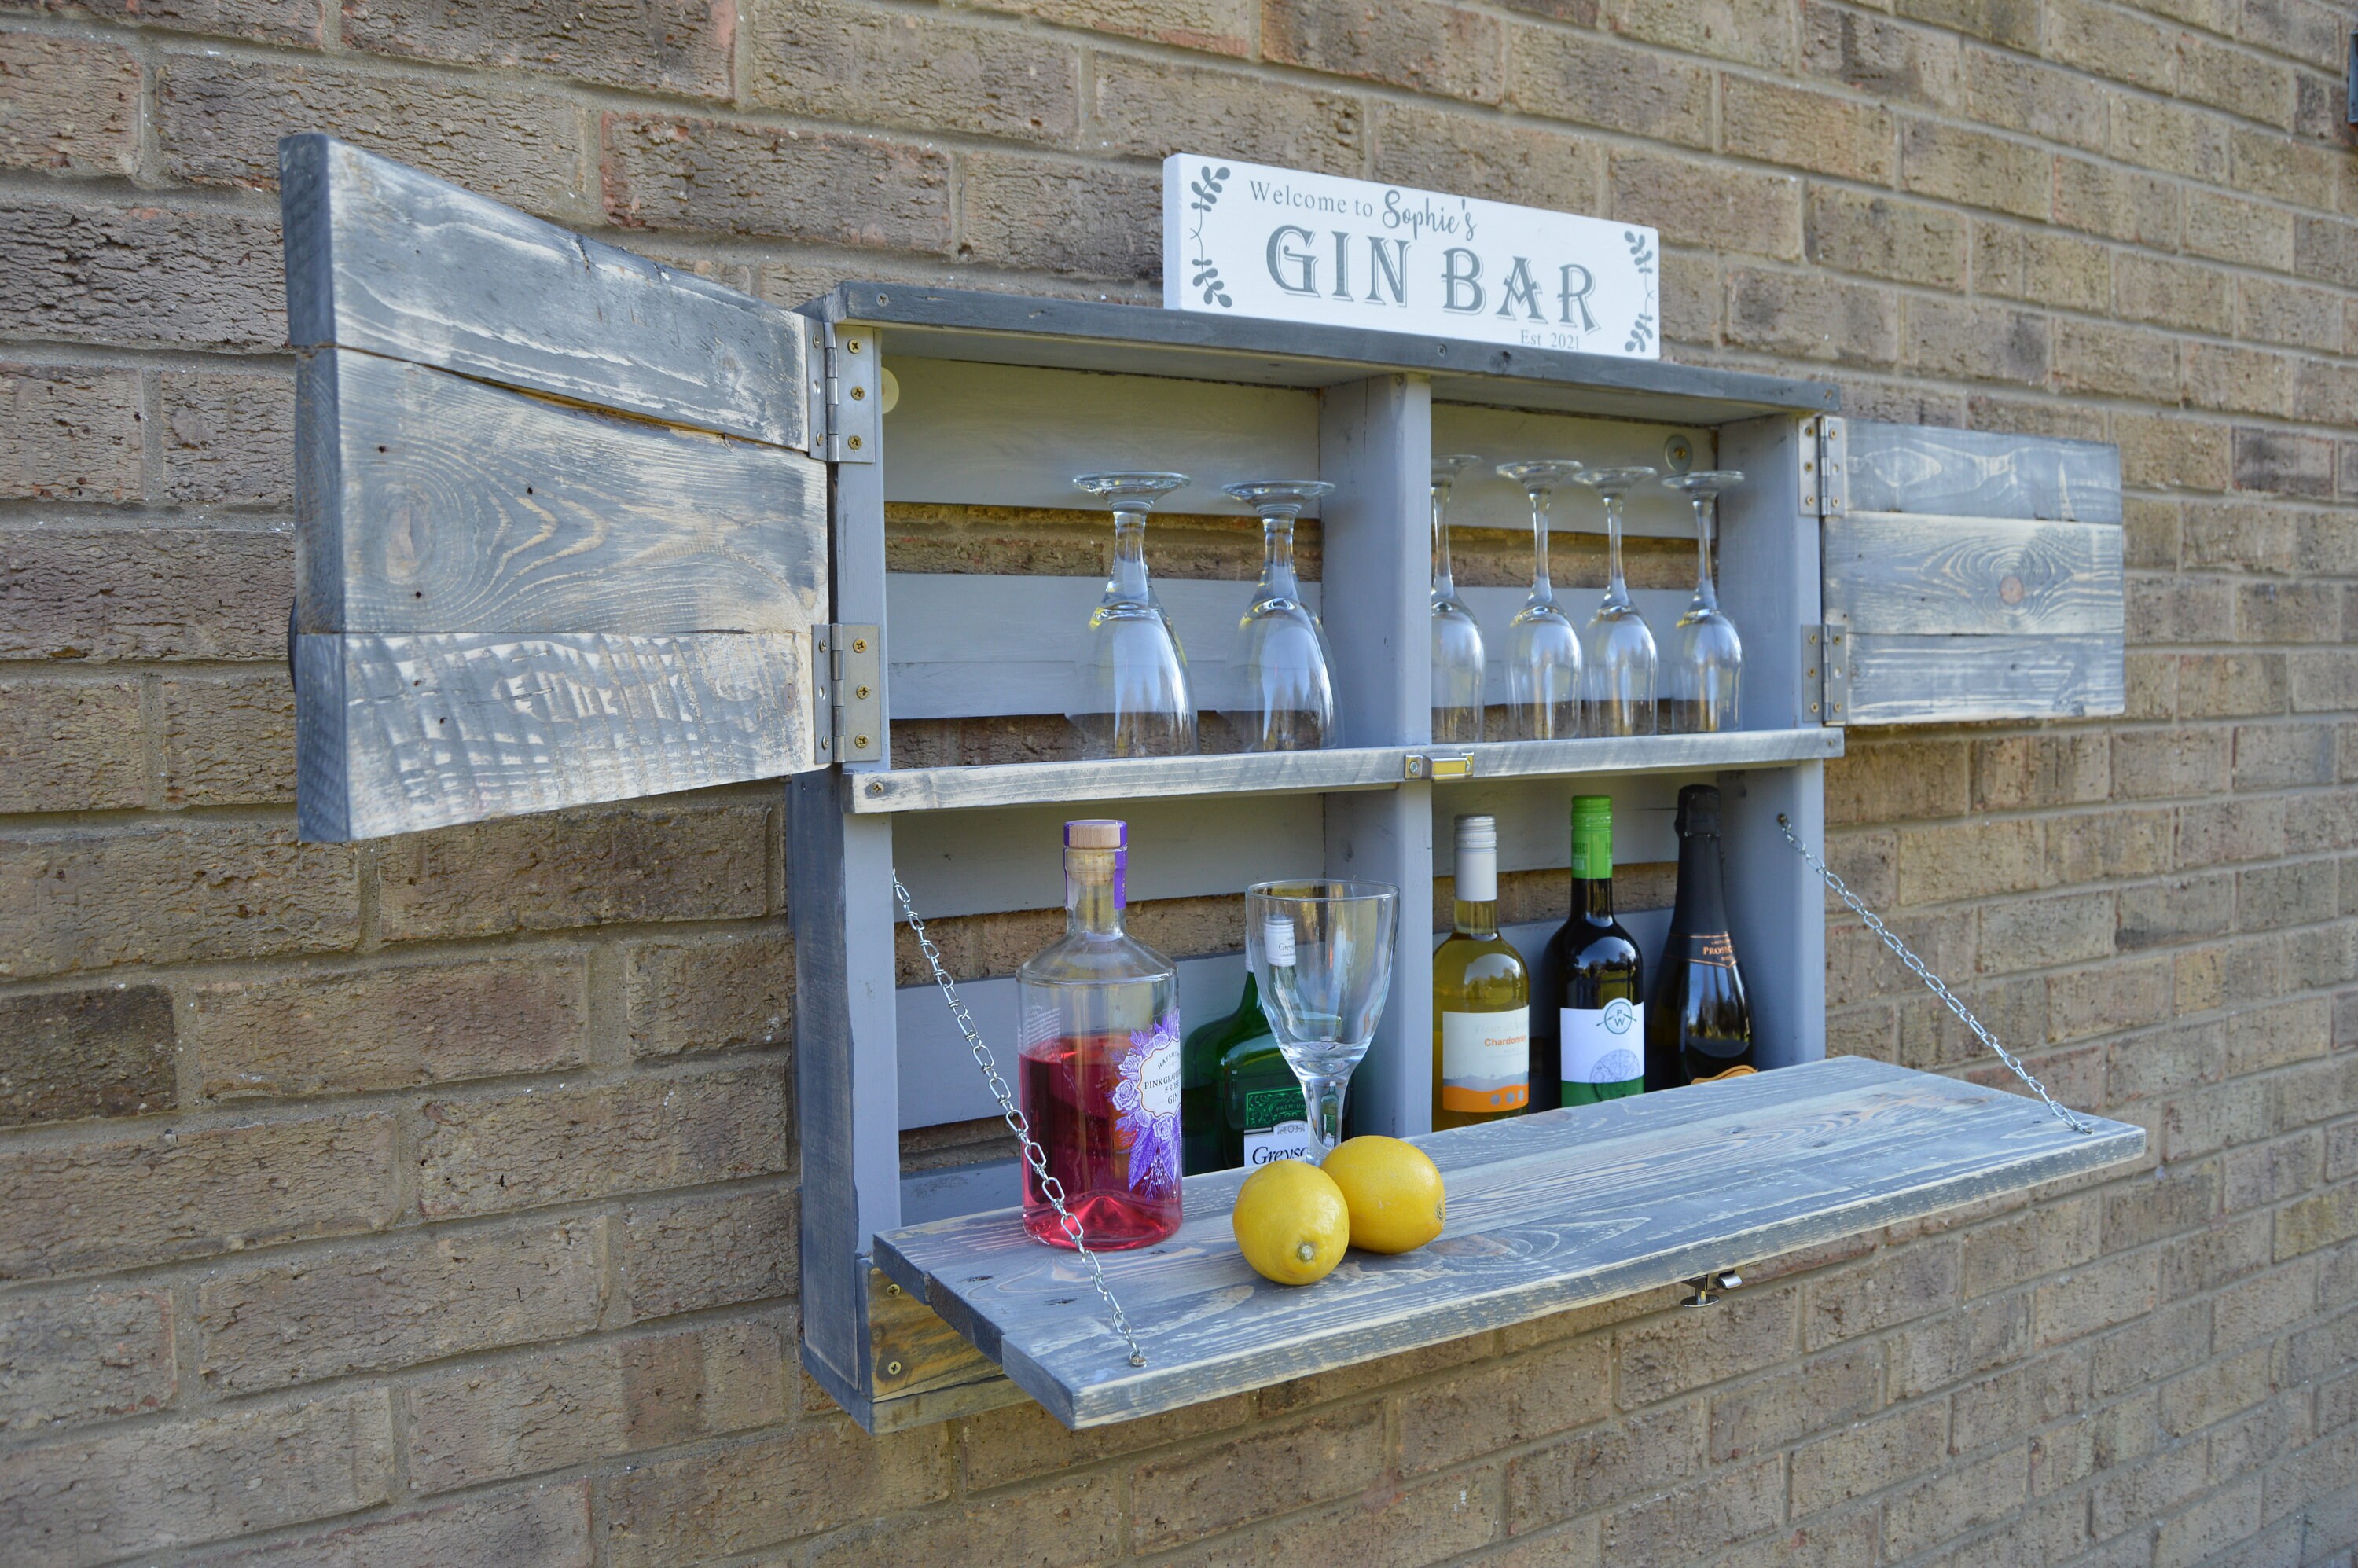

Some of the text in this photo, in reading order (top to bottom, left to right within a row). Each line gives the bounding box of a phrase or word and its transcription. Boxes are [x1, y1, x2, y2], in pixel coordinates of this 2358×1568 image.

[1250, 180, 1477, 241] Welcome to Sophie's
[1266, 224, 1601, 335] GIN BAR
[1521, 329, 1579, 351] Est 2021
[1614, 1017, 1625, 1027] W
[1144, 1078, 1163, 1089] PINK
[1167, 1092, 1179, 1105] GIN
